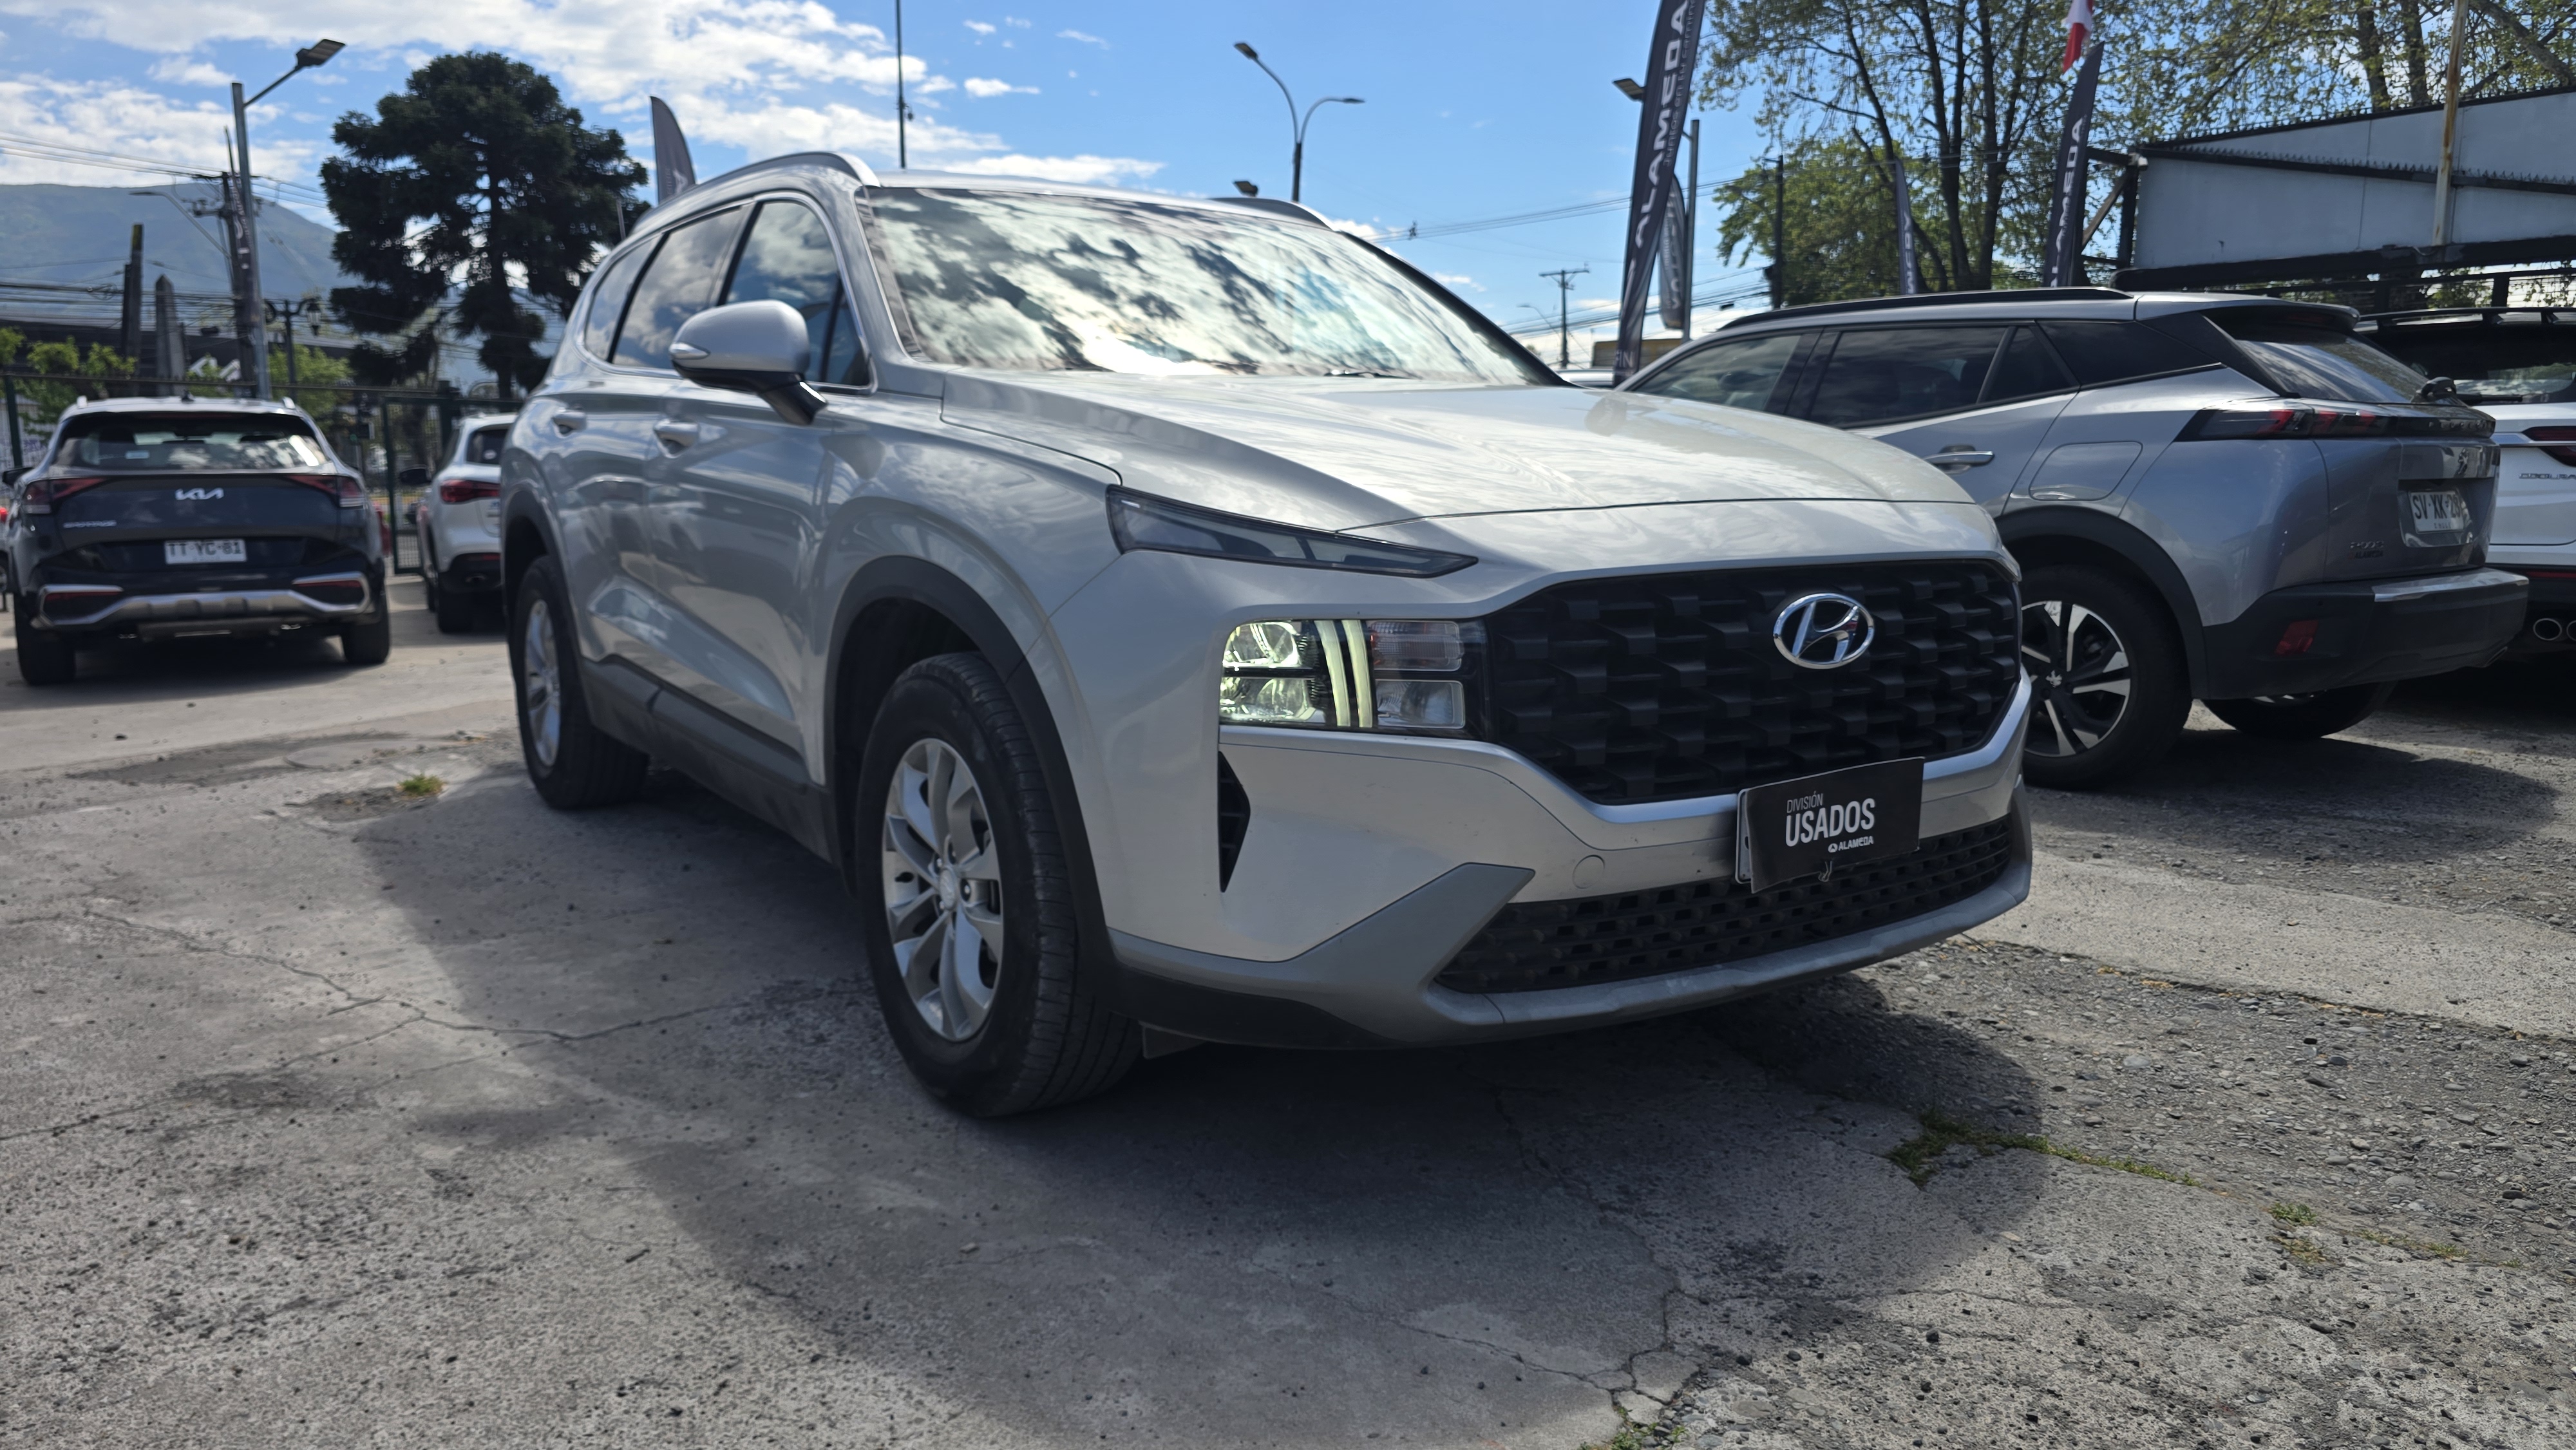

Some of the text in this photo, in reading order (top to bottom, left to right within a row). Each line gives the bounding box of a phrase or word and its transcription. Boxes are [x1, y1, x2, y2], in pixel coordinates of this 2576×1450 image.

[1635, 0, 1689, 249] ALAMEDA
[1786, 790, 1824, 813] DIVISIÓN
[1786, 798, 1875, 847] USADOS
[1839, 835, 1874, 851] ALAMEDA
